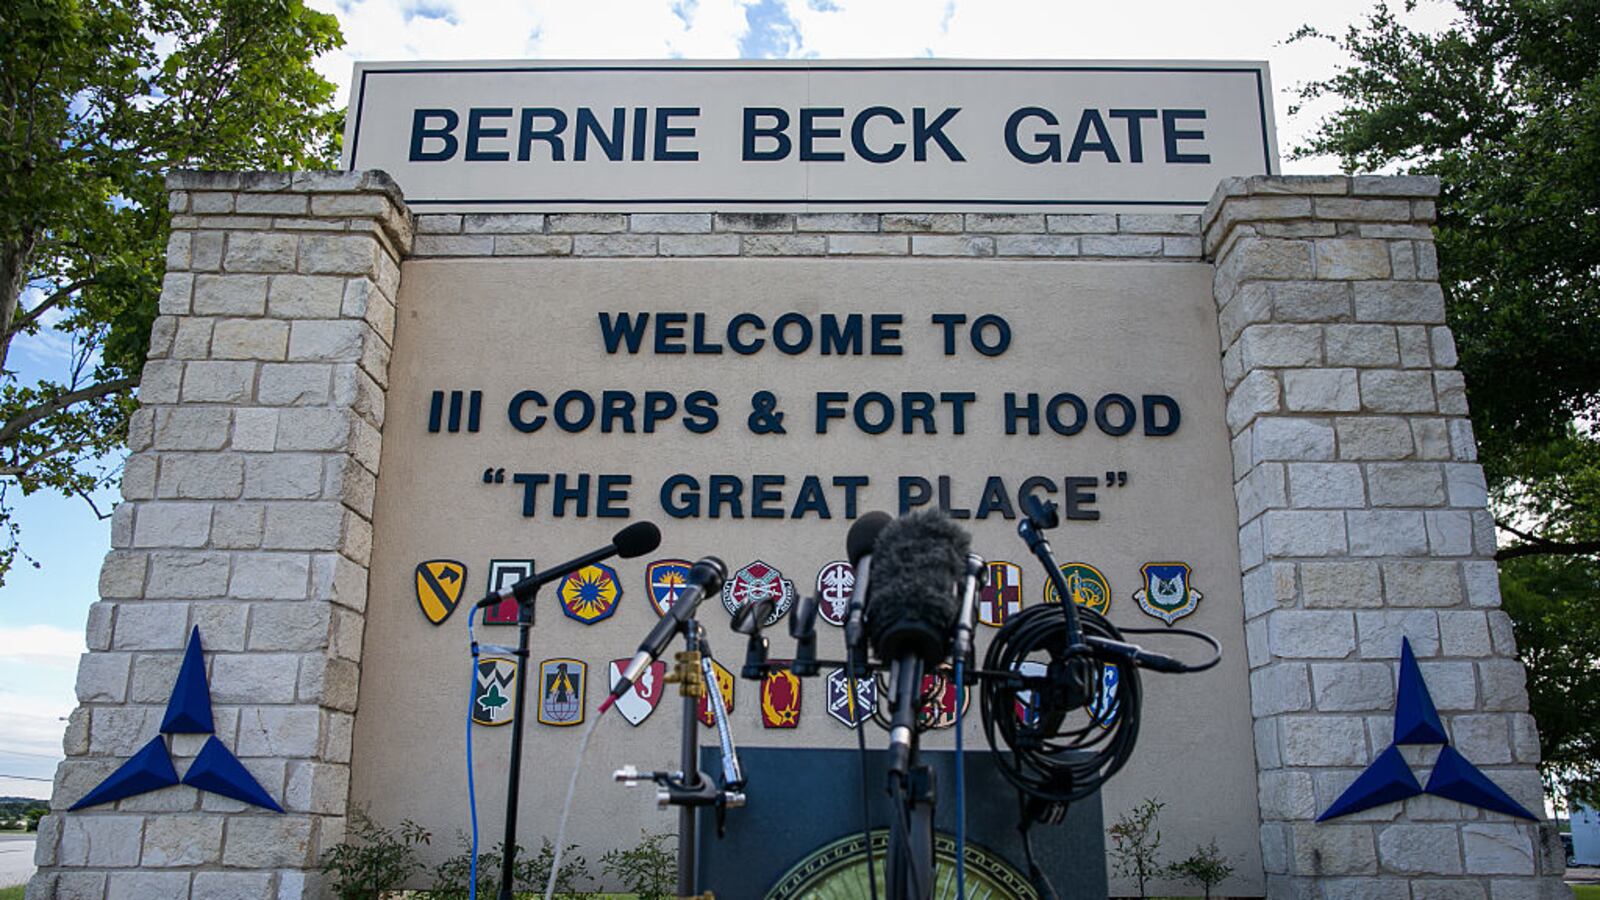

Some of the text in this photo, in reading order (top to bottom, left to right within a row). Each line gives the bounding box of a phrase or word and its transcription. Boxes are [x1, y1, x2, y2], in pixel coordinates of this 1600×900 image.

[409, 106, 1211, 164] BERNIE BECK GATE
[599, 312, 1011, 357] WELCOME TO
[428, 390, 1181, 437] III CORPS & FORT HOOD
[660, 473, 869, 519] GREAT
